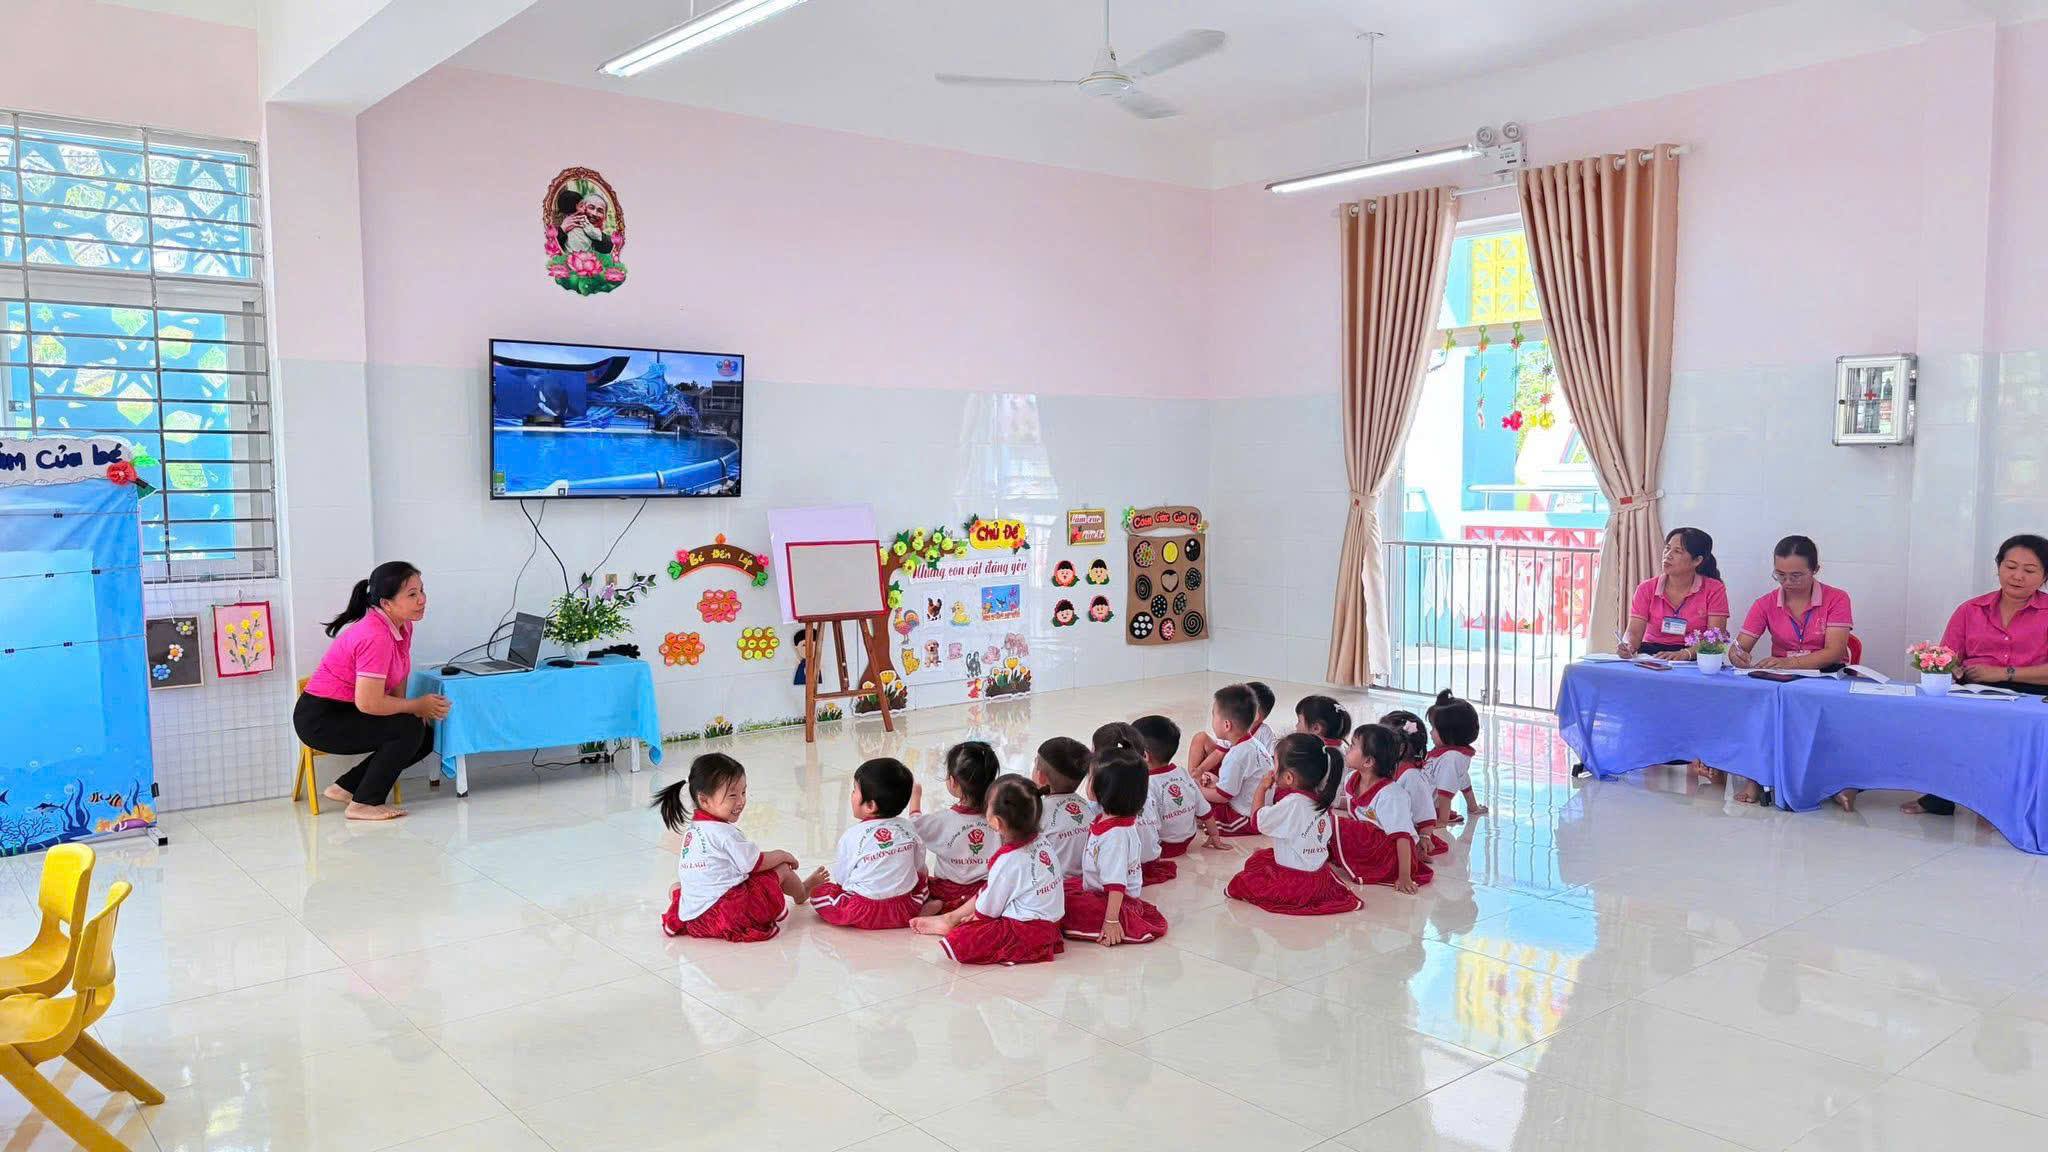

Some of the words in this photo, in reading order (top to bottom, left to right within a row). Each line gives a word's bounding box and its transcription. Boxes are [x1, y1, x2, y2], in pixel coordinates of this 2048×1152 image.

[92, 443, 122, 466] bé
[688, 551, 705, 567] Bé
[949, 566, 965, 577] con
[984, 559, 1009, 576] đáng
